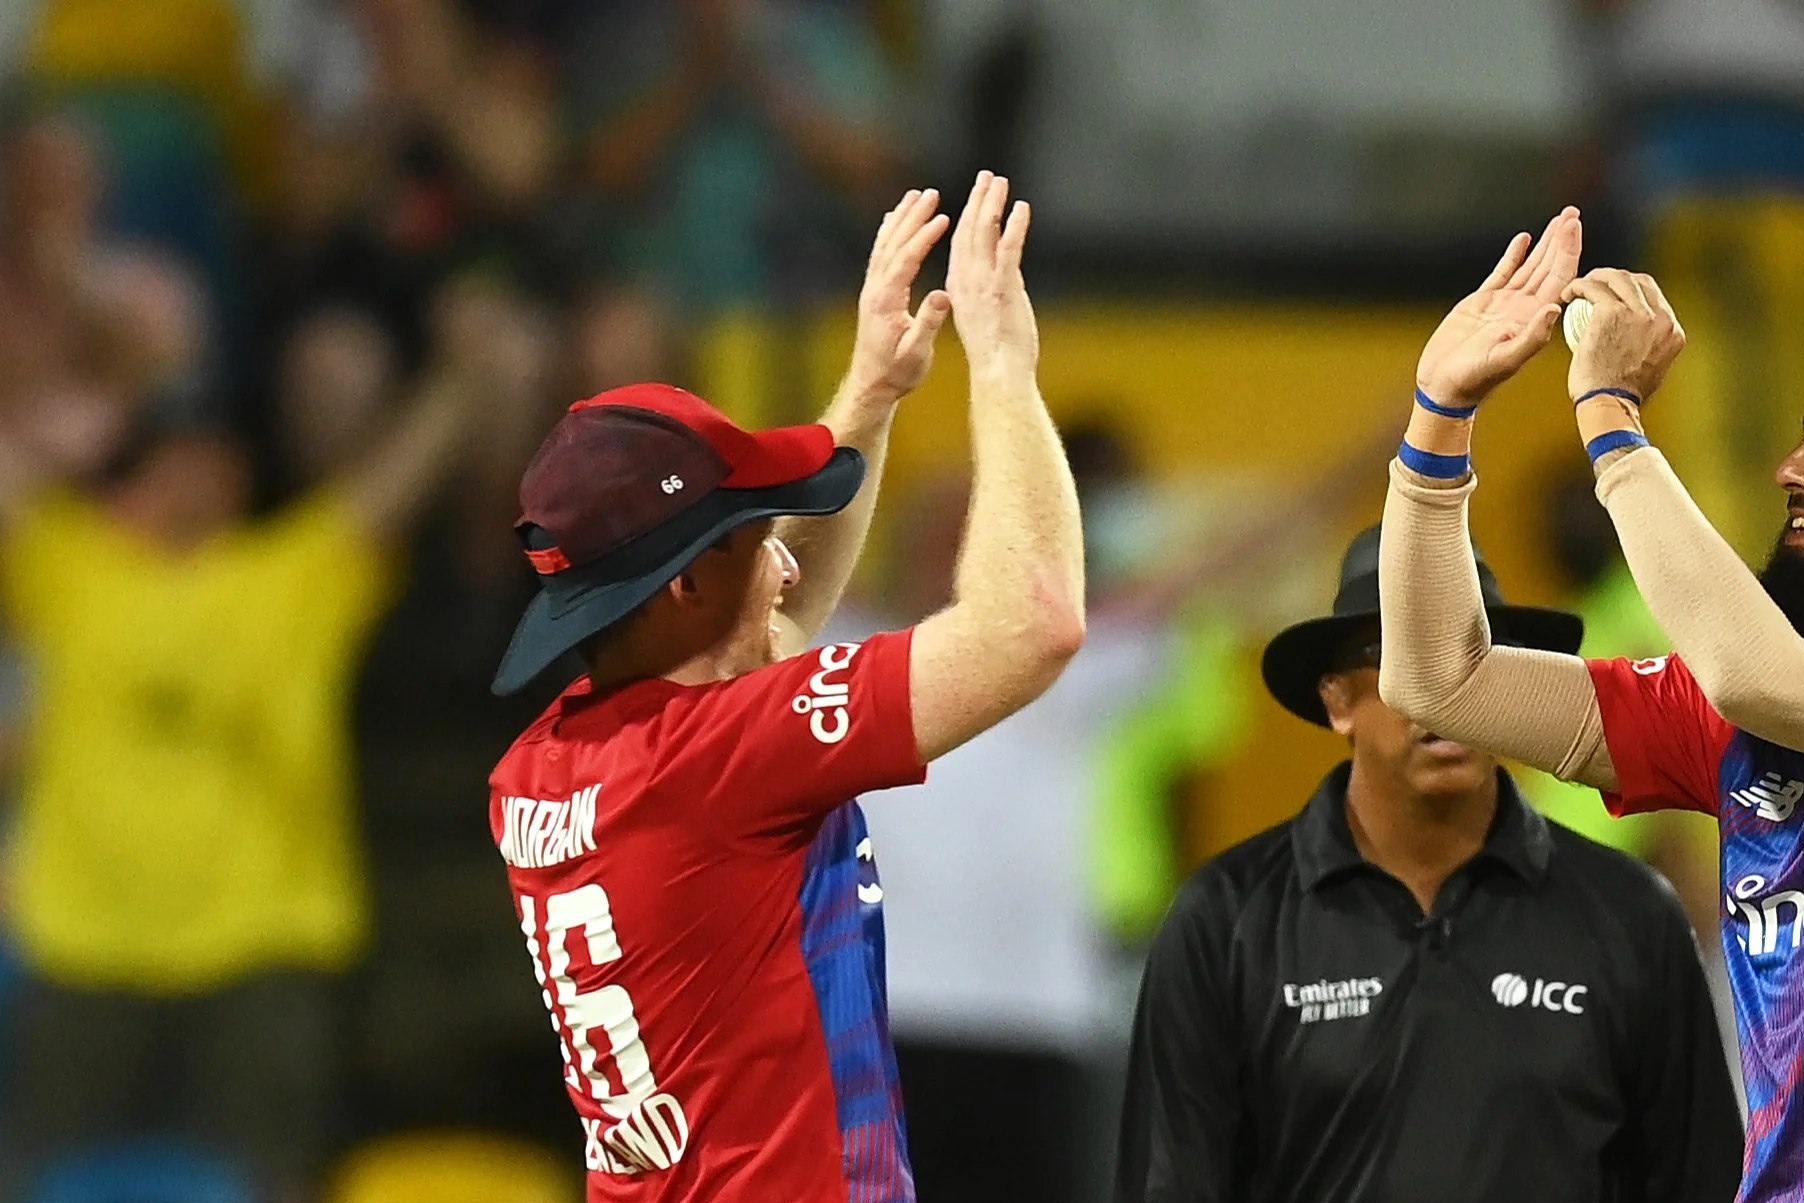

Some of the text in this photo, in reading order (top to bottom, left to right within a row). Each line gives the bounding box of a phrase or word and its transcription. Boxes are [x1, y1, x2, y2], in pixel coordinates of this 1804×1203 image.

[660, 474, 684, 496] 66
[791, 643, 862, 744] cinc
[520, 883, 658, 1120] 16
[1283, 977, 1383, 1007] Emirates
[1531, 978, 1588, 1015] ICC
